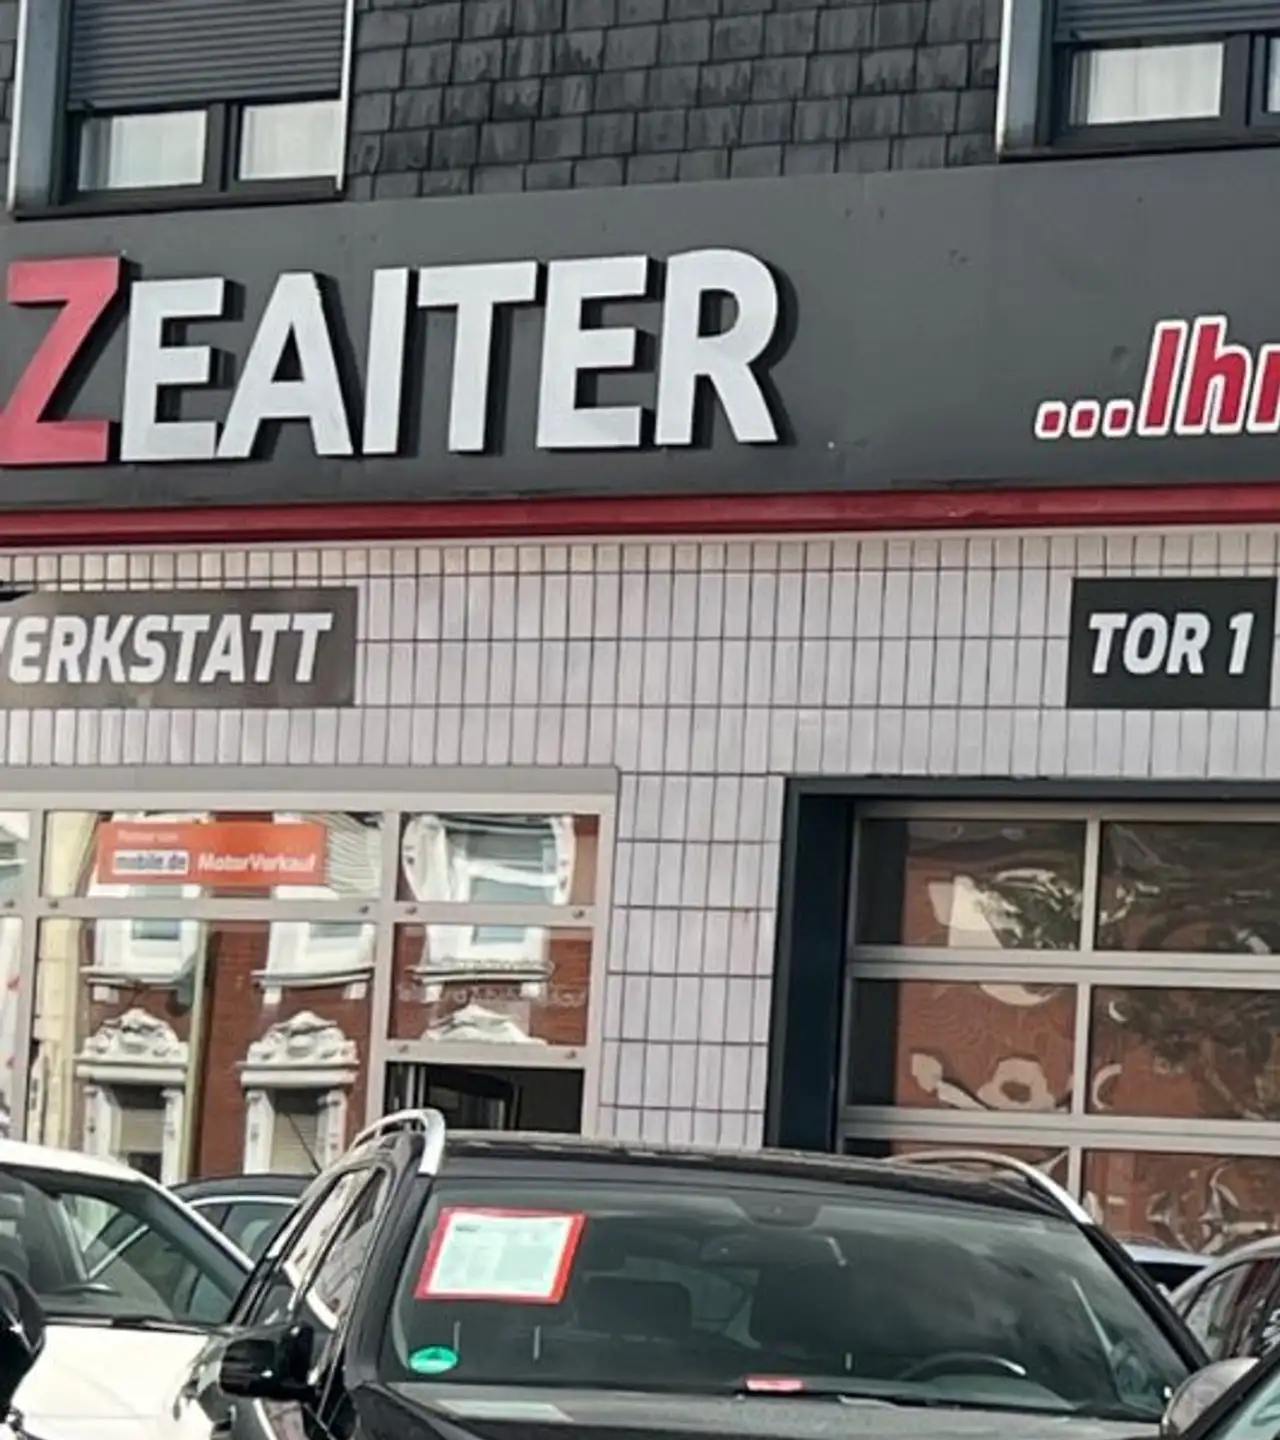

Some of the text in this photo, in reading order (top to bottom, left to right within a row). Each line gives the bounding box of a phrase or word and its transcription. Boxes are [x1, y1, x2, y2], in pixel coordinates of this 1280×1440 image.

[0, 249, 778, 463] ZEAITER
[0, 612, 333, 684] ERKSTATT
[1088, 612, 1254, 675] TOR 1
